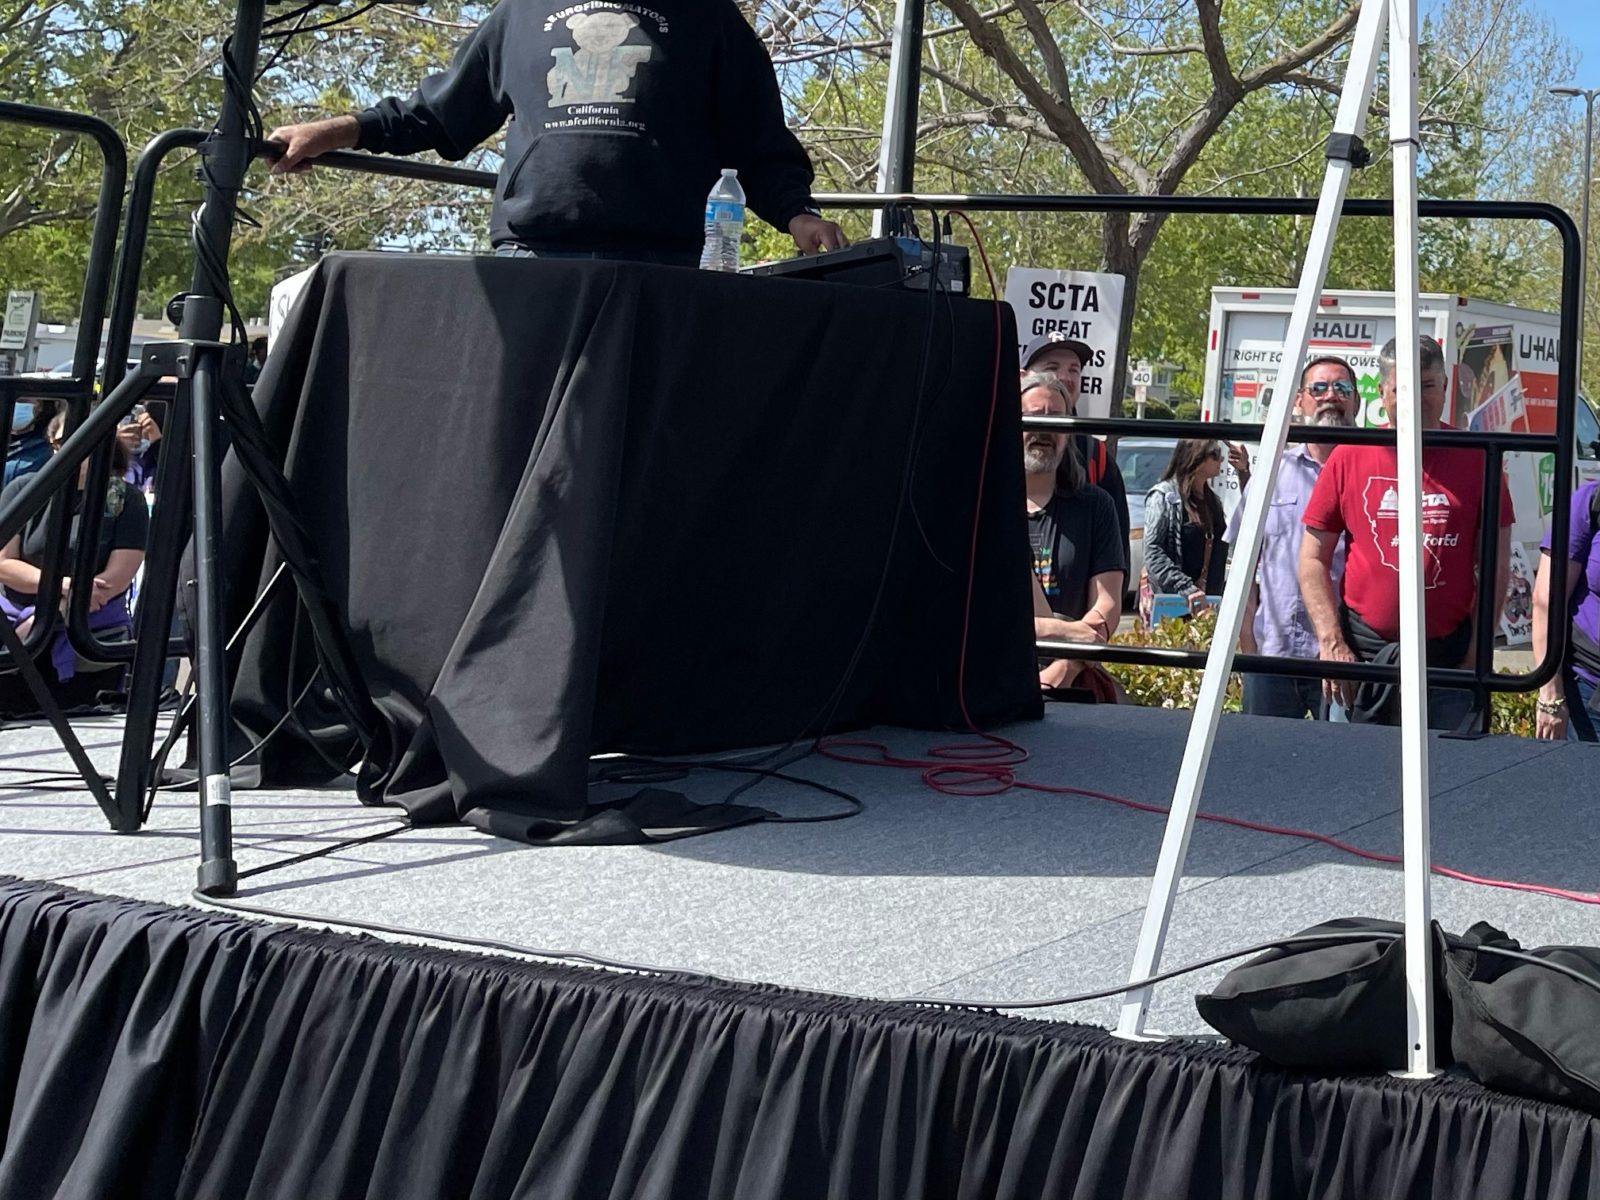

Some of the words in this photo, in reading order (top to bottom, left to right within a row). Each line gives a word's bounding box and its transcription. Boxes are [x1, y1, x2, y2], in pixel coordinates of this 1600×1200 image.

[567, 105, 620, 115] California
[1028, 281, 1100, 313] SCTA
[1031, 318, 1092, 339] GREAT
[1232, 349, 1267, 363] RIGHT
[1133, 372, 1151, 384] 40
